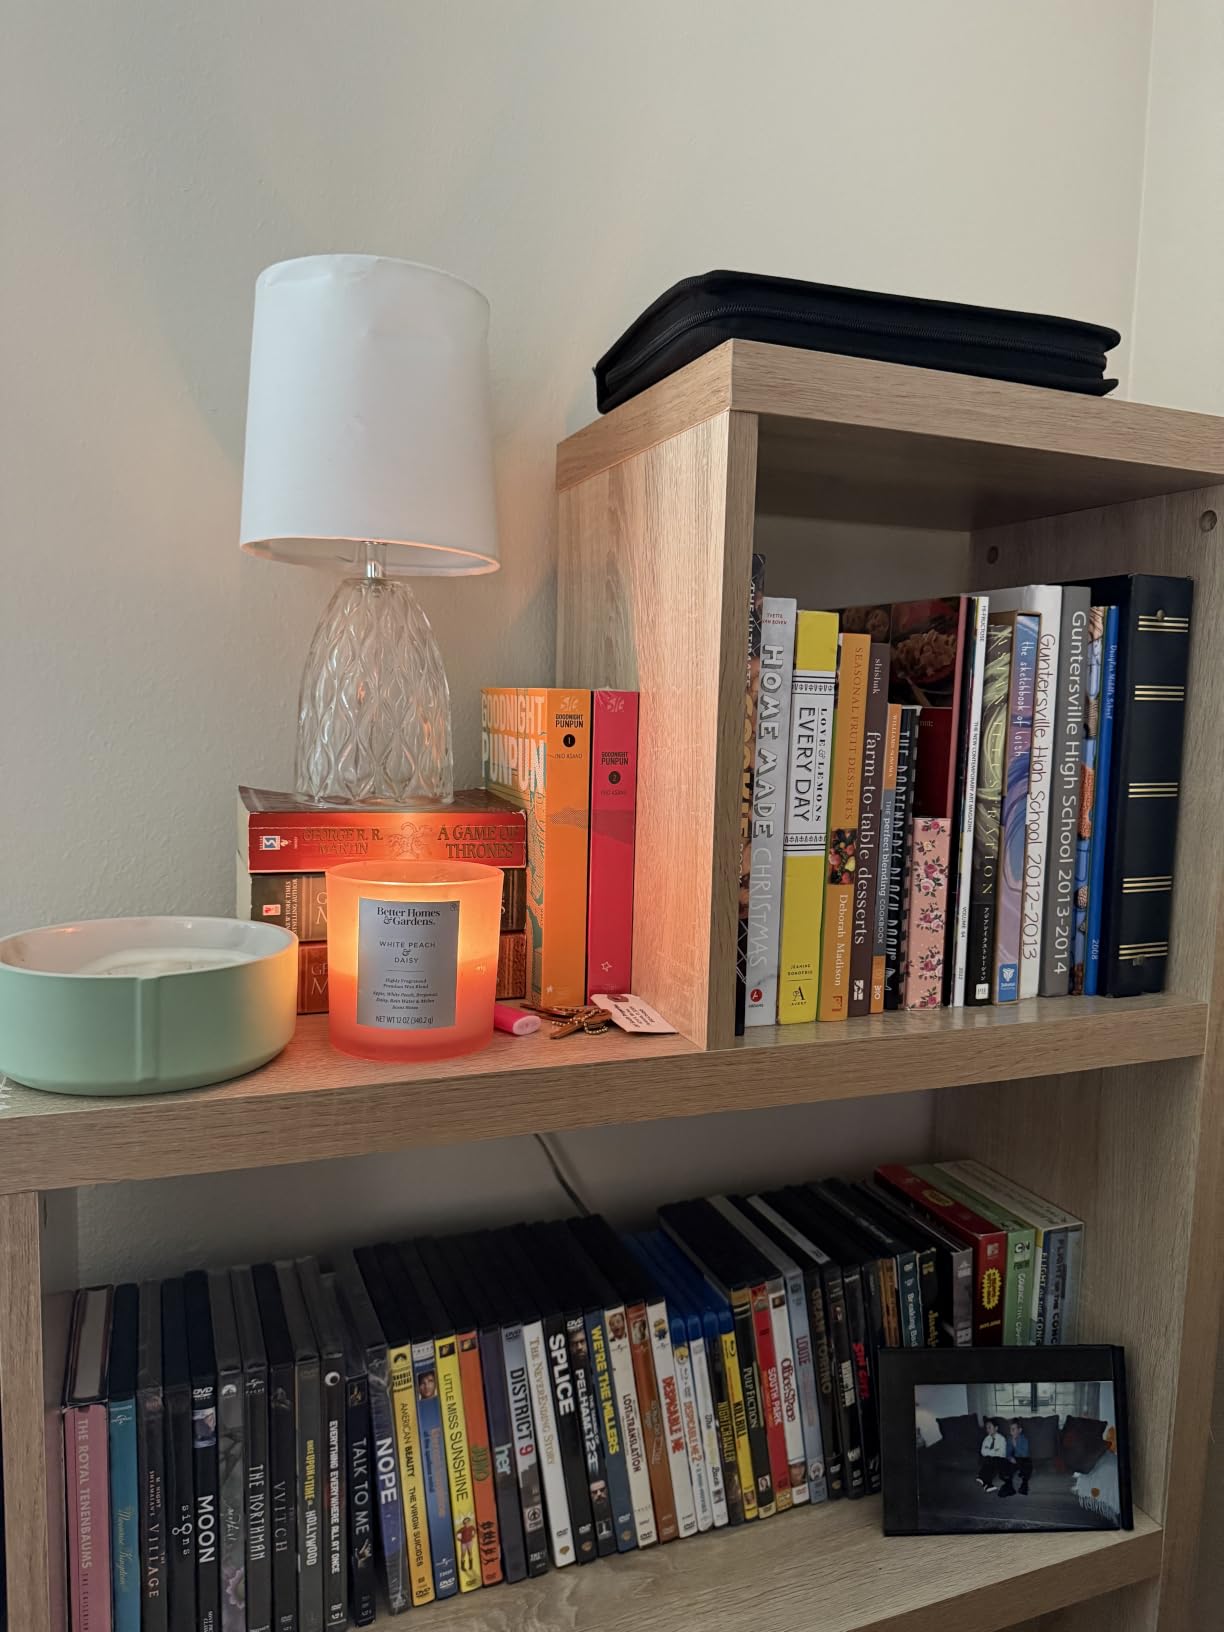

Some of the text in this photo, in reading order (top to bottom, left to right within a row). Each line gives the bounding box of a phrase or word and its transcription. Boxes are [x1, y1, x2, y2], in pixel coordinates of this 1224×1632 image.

[482, 694, 545, 736] GOODNIGHT
[556, 720, 583, 728] PUNPUN
[1013, 641, 1034, 757] the sketchbook of loish
[482, 731, 546, 796] PUNPUN
[601, 757, 629, 765] PUNPUN
[752, 645, 785, 838] HOME MADE
[793, 707, 816, 822] EVERY DAY
[815, 708, 828, 822] LOVE & LEMONS
[845, 647, 863, 821] SEASONAL FRUIT DESSERTS
[1022, 634, 1056, 960] Guntersville High School 2012-2013
[1053, 611, 1086, 975] Guntersville High School 2013-2014
[303, 828, 383, 841] GEORGE R. R.
[320, 842, 369, 854] MARTIN
[437, 824, 518, 841] A GAME OF
[446, 843, 513, 858] THRONES
[854, 732, 881, 945] farm-to-table desserts
[882, 817, 891, 853] perfect
[750, 848, 773, 968] CHRISTMAS
[879, 854, 890, 896] blending
[377, 907, 440, 917] Better Homes
[834, 895, 849, 986] Deborah Madison
[877, 898, 886, 944] COOKBOOK
[1091, 939, 1100, 960] 2008
[1039, 1252, 1048, 1288] FLIGHT
[529, 1336, 540, 1360] THE
[810, 1287, 833, 1394] GRAN TORINO
[907, 1293, 919, 1347] Breaking Bad
[549, 1333, 575, 1416] SPLICE
[574, 1368, 591, 1430] PELHAM
[591, 1325, 620, 1455] WE'RE THE MILLERS
[661, 1375, 682, 1436] DESPICABLE
[743, 1366, 759, 1429] PULP FICTION
[768, 1366, 783, 1425] SOUTH PARK
[400, 1402, 416, 1477] AMERICAN BEAUTY
[443, 1373, 469, 1502] LITTLE MISS SUNSHINE
[510, 1367, 534, 1457] DISTRICT 9
[623, 1393, 642, 1473] LOST TRANSLATION
[717, 1401, 736, 1463] NIGHTCRAWLER
[303, 1478, 316, 1501] TIME
[305, 1454, 316, 1475] UPON
[352, 1437, 370, 1536] TALK TO ME
[376, 1437, 397, 1505] NOPE
[494, 1443, 513, 1475] her
[77, 1419, 93, 1569] THE ROYAL TENENBAUMS
[248, 1464, 265, 1561] THE NORTHMAN
[329, 1420, 341, 1574] EVERYTHING EVERYWHERE ALL AT ONCE
[408, 1487, 424, 1567] THE VIRGIN SUICIDES
[148, 1522, 160, 1598] VILLAGE
[197, 1494, 215, 1564] MOON
[305, 1510, 318, 1566] HOLLYWOOD
